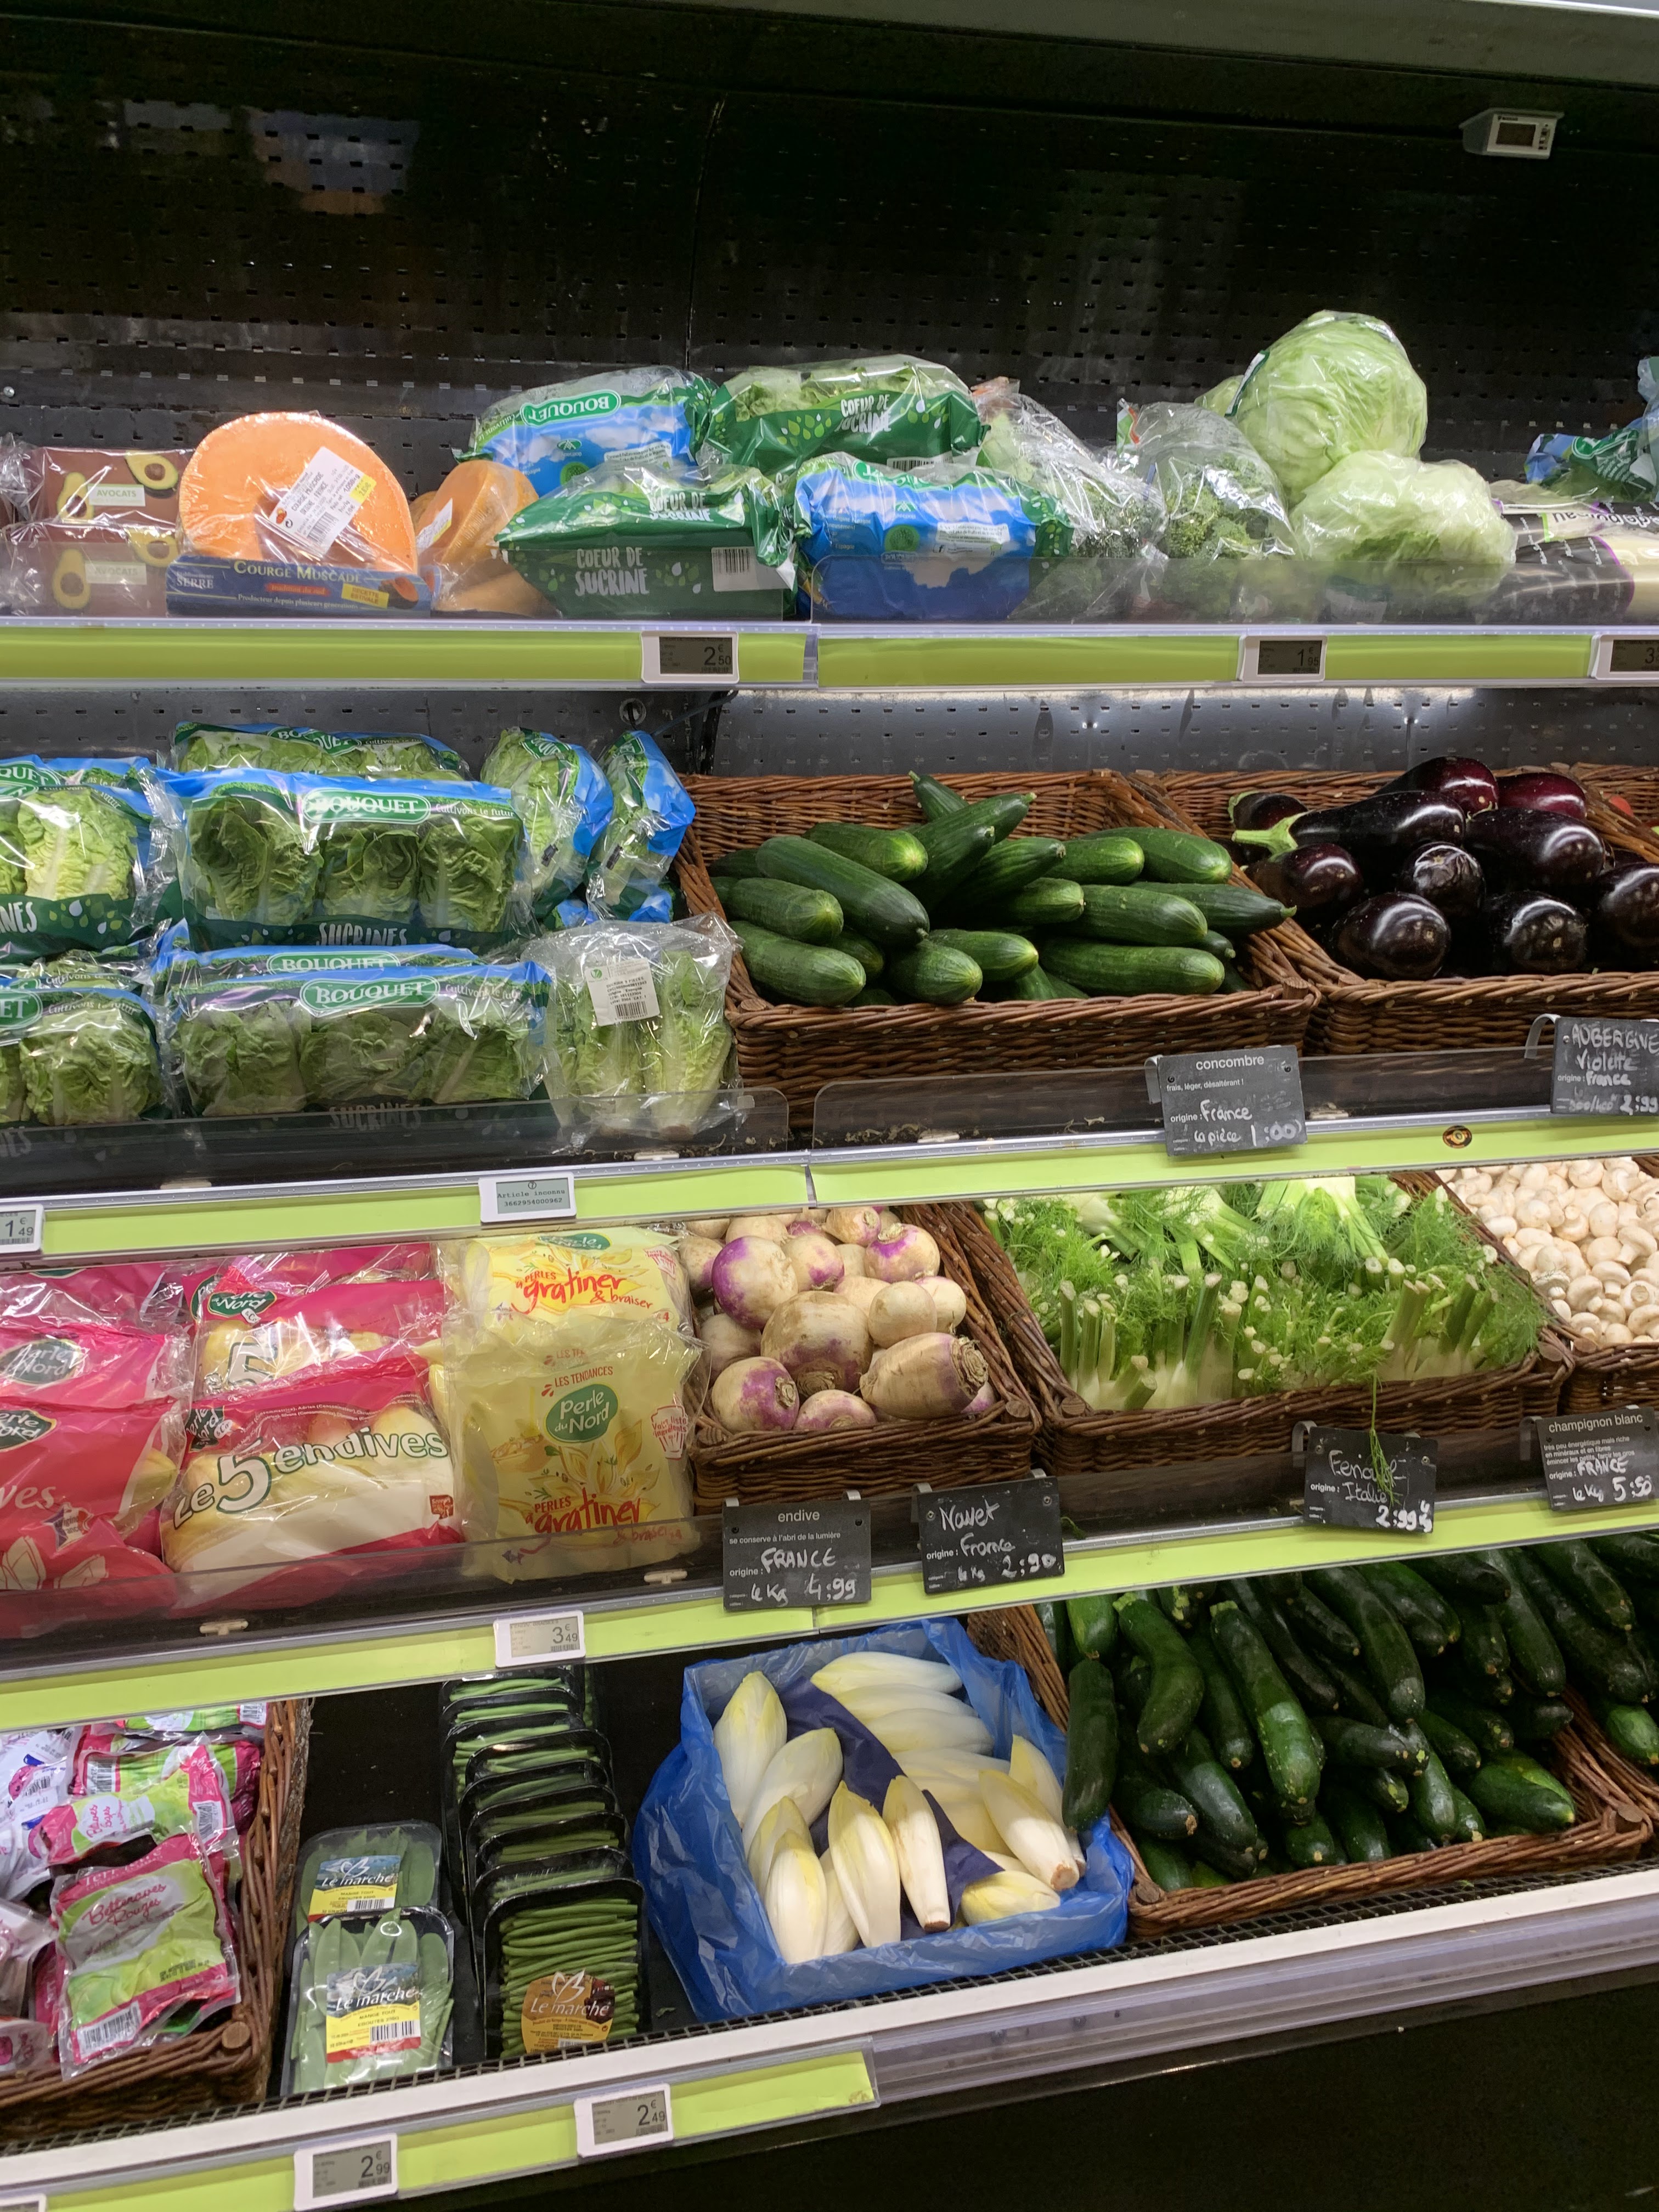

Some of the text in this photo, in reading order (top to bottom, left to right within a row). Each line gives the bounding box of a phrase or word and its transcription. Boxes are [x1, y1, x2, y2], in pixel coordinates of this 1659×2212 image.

[529, 396, 610, 420] BOUQUET
[877, 394, 890, 410] DE
[691, 492, 708, 510] DE
[577, 547, 643, 568] COEUR DE
[234, 561, 361, 583] COURGE MUSCADE
[176, 577, 214, 589] SERRE
[575, 568, 650, 596] SUCRINE
[238, 593, 273, 603] Producteur
[274, 597, 295, 606] depuis
[295, 598, 324, 608] plusieurs
[352, 588, 380, 597] RECETTE
[315, 795, 515, 818] BOUQUET Cultivons le futur
[317, 922, 407, 945] SUCRINES
[316, 982, 426, 1005] BOUQUET
[48, 1000, 94, 1014] Cultivons
[1195, 1055, 1265, 1070] concombre
[1166, 1084, 1183, 1092] frais,
[1184, 1081, 1203, 1092] léger,
[1558, 1070, 1632, 1087] origine France
[1170, 1099, 1252, 1124] origine France
[504, 1198, 563, 1207] 3662954000962
[5, 1220, 33, 1238] 1 49
[524, 1271, 556, 1283] PERLES
[511, 1267, 627, 1314] gratiner
[610, 1288, 653, 1309] braiser
[217, 1295, 267, 1311] Nord
[555, 1366, 614, 1388] LES TENDANCES
[554, 1401, 610, 1434] du Nord
[1548, 1414, 1644, 1434] champignon blanc
[1567, 1438, 1601, 1449] énergétique
[1547, 1457, 1570, 1466] émincer
[1553, 1449, 1579, 1458] minéraux
[216, 1436, 272, 1514] 5
[273, 1426, 449, 1474] endives
[1549, 1455, 1629, 1481] origine FRANCE
[1310, 1483, 1336, 1493] origine
[534, 1495, 572, 1514] PERLES
[777, 1509, 821, 1522] endive
[939, 1498, 1001, 1532] Navet
[739, 1536, 771, 1544] conserve
[778, 1533, 797, 1542] l'abri
[815, 1531, 841, 1539] lumière
[729, 1547, 837, 1578] origine FRANCE
[926, 1549, 955, 1560] origine
[552, 1626, 578, 1644] 3 49
[321, 1877, 338, 1888] Le
[336, 1997, 353, 2011] Le
[530, 1997, 611, 2017] Le marché
[637, 2104, 665, 2126] 2 49
[361, 2155, 390, 2178] 2 99
